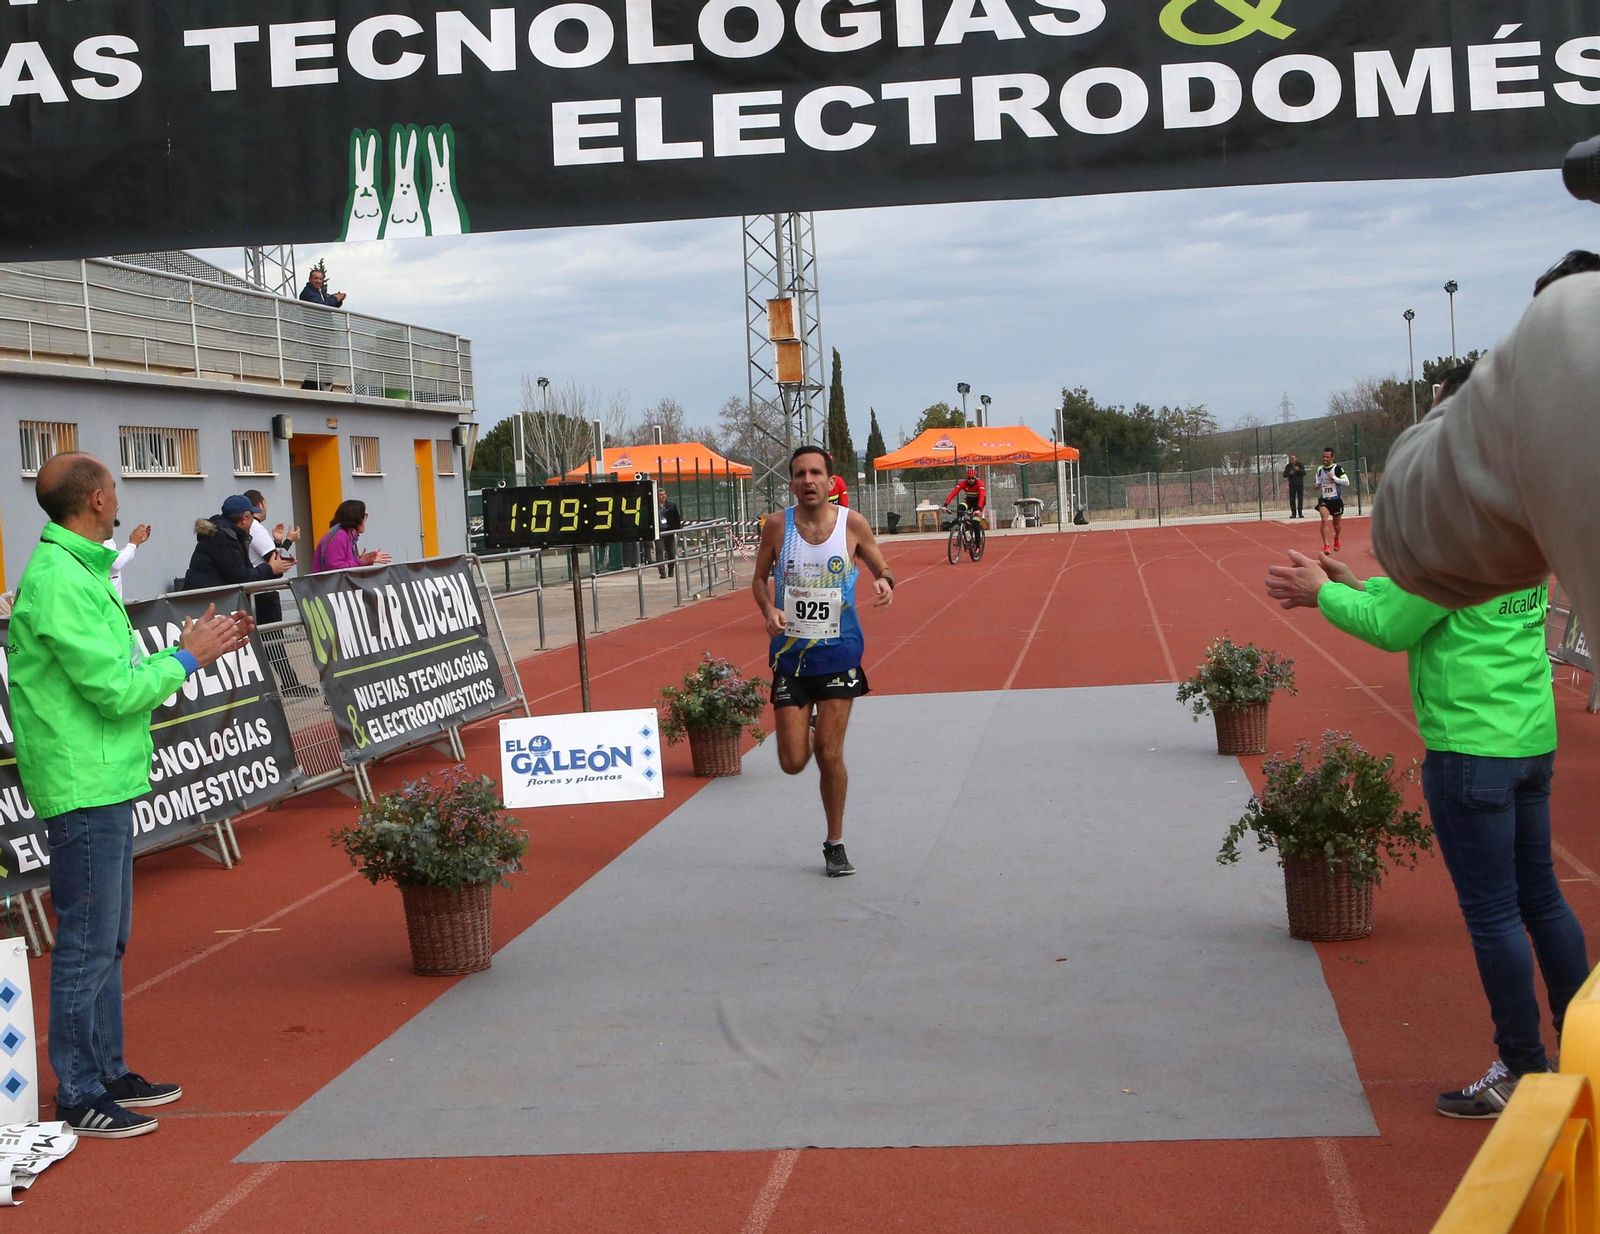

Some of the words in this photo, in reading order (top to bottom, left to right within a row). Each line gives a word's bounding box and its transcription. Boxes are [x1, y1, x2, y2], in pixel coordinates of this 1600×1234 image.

[996, 452, 1032, 462] LUCENA
[510, 496, 642, 533] 1:09:34
[401, 572, 482, 641] LUCENA
[796, 600, 830, 621] 925
[354, 675, 410, 712] NUEVAS
[408, 649, 489, 694] TECNOLOGÍAS
[346, 704, 371, 749] &
[366, 677, 496, 744] ELECTRODOMESTICOS
[505, 739, 526, 753] EL
[511, 744, 633, 777] GALEÓN
[526, 776, 562, 788] flores
[564, 777, 573, 786] y
[575, 773, 623, 784] plantas
